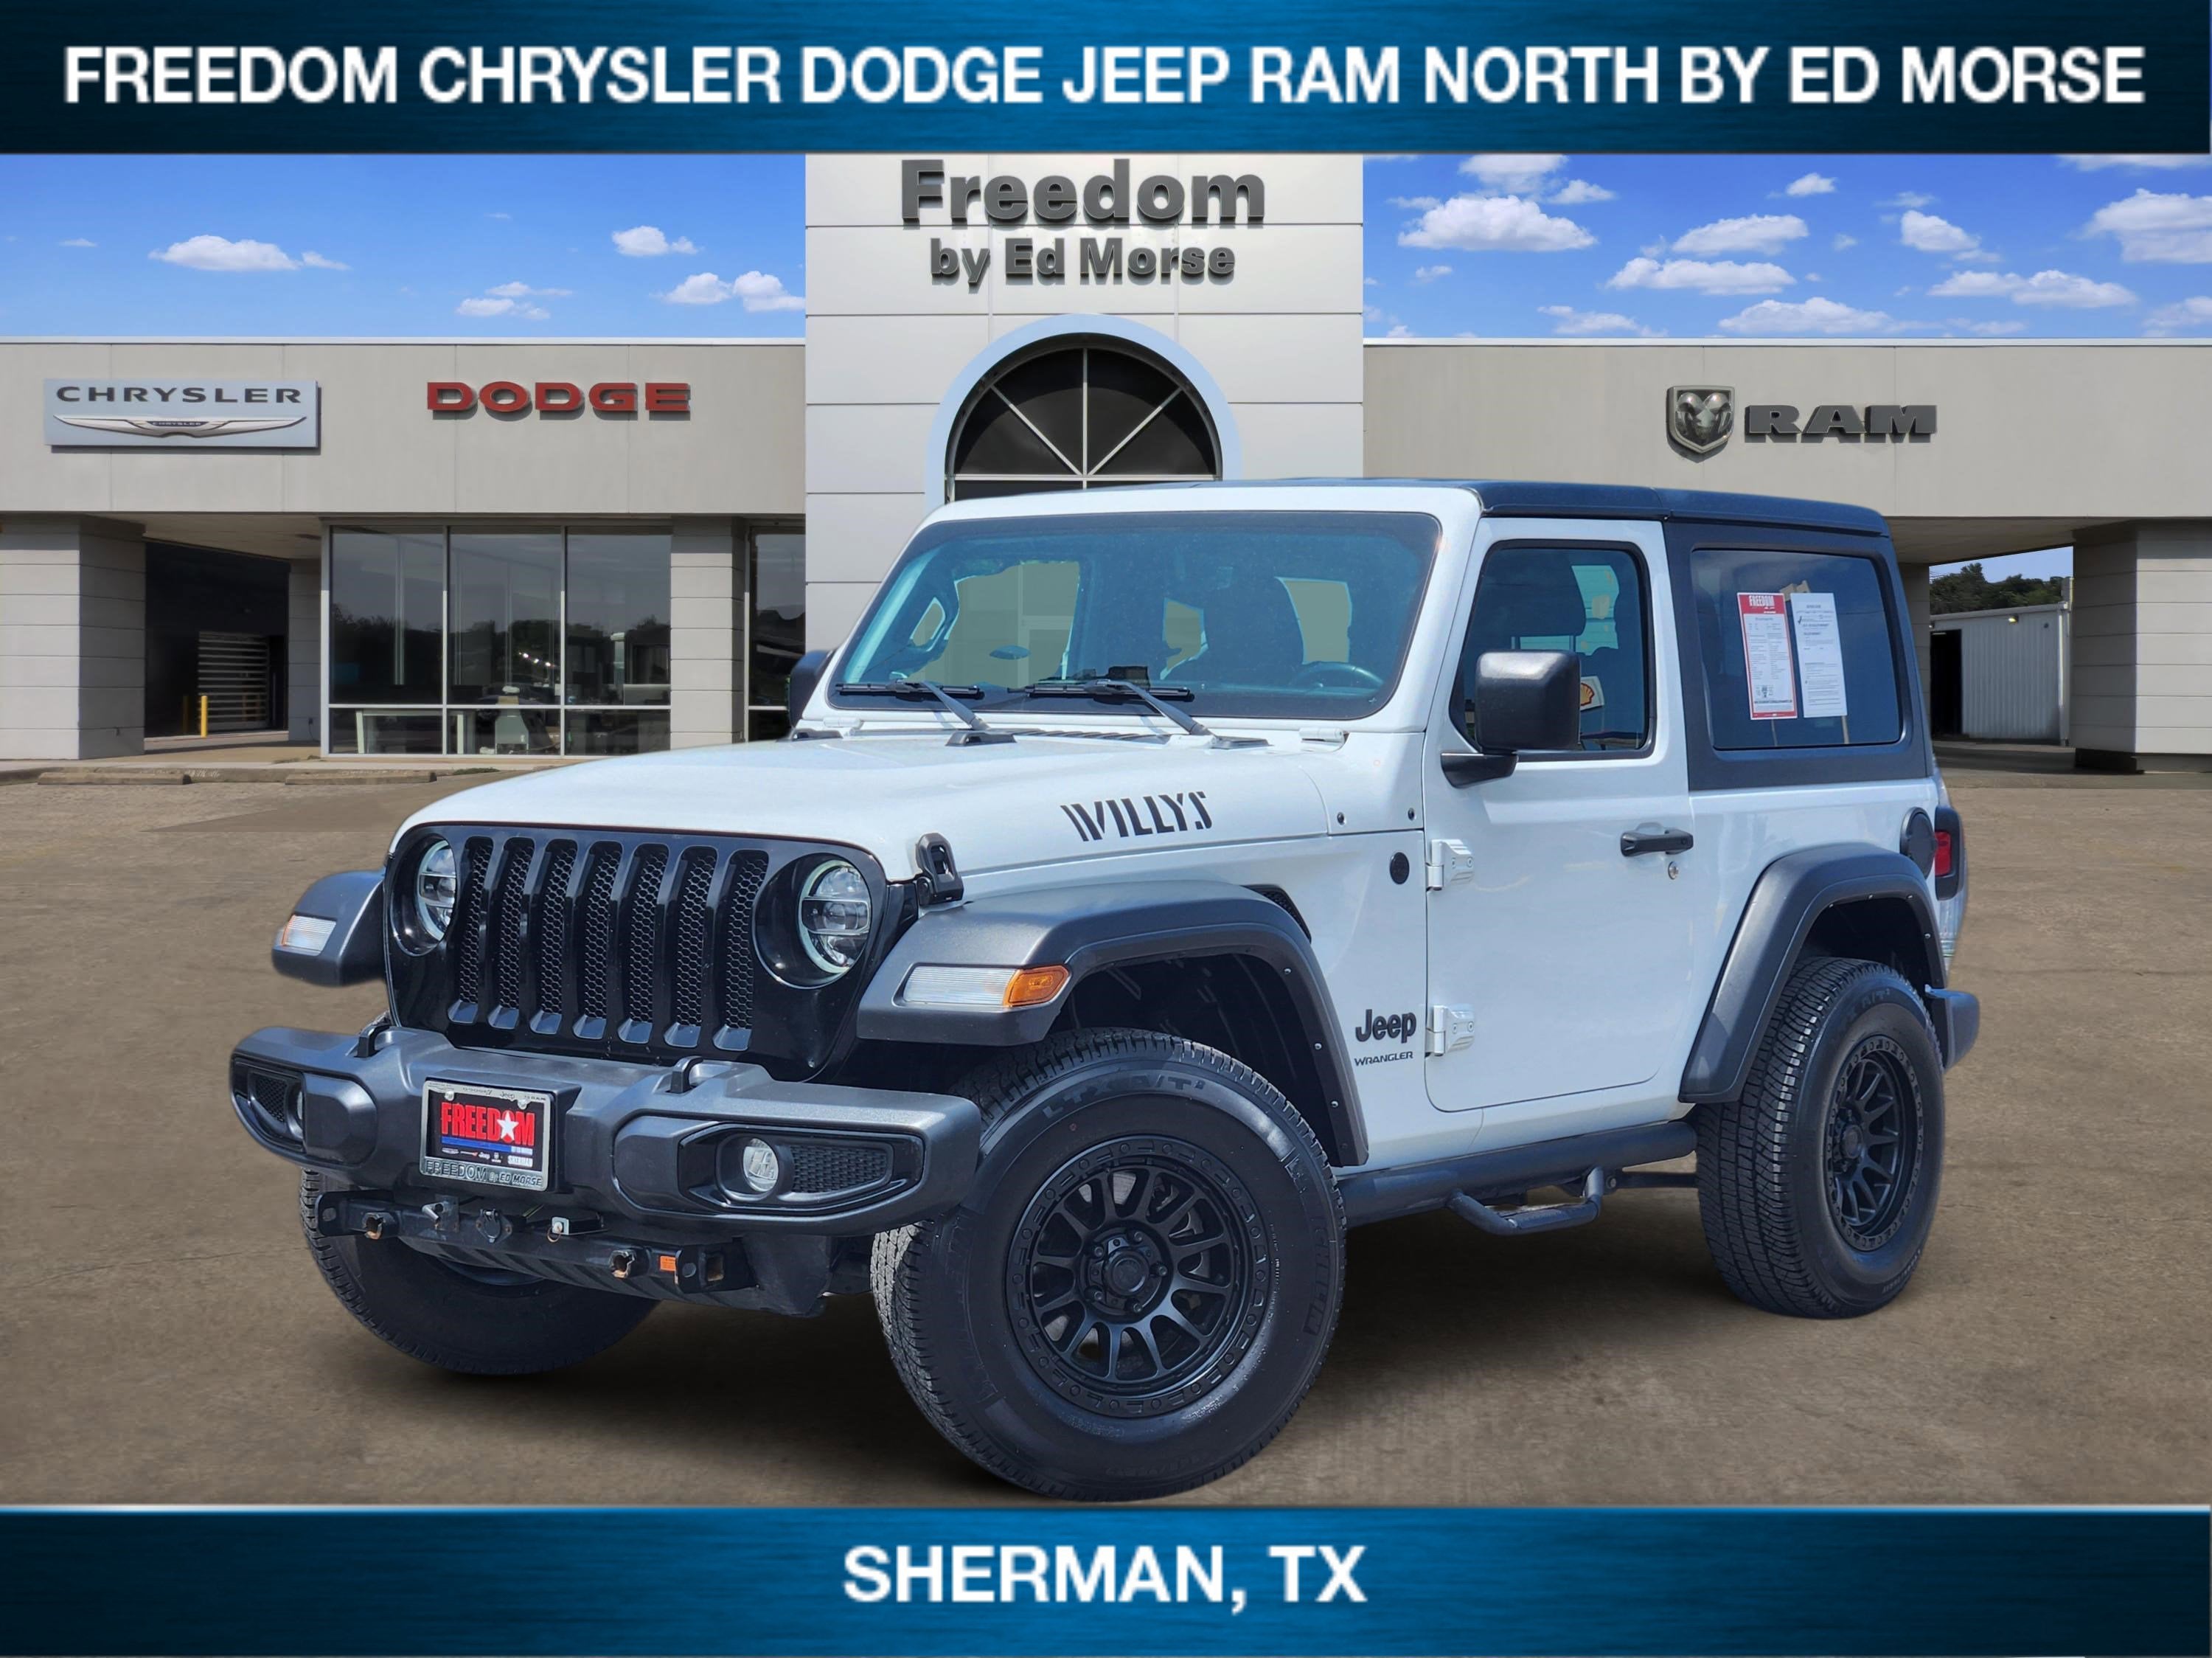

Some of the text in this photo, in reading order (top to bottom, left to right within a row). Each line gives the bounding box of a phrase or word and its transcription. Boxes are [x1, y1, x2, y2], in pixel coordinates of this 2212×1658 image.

[901, 158, 1265, 225] Freedom
[930, 237, 1236, 286] by Ed Morse
[55, 385, 302, 404] CHRYSLER
[427, 381, 690, 412] DODGE
[1745, 404, 1938, 434] RAM
[1060, 791, 1213, 842] WILLYS
[1354, 1008, 1417, 1044] Jeep
[1354, 1051, 1413, 1066] WRANGLER
[441, 1102, 535, 1146] FREEDOM
[425, 1158, 487, 1182] FREEDOM
[499, 1171, 512, 1184] ED
[512, 1173, 543, 1187] MORSE
